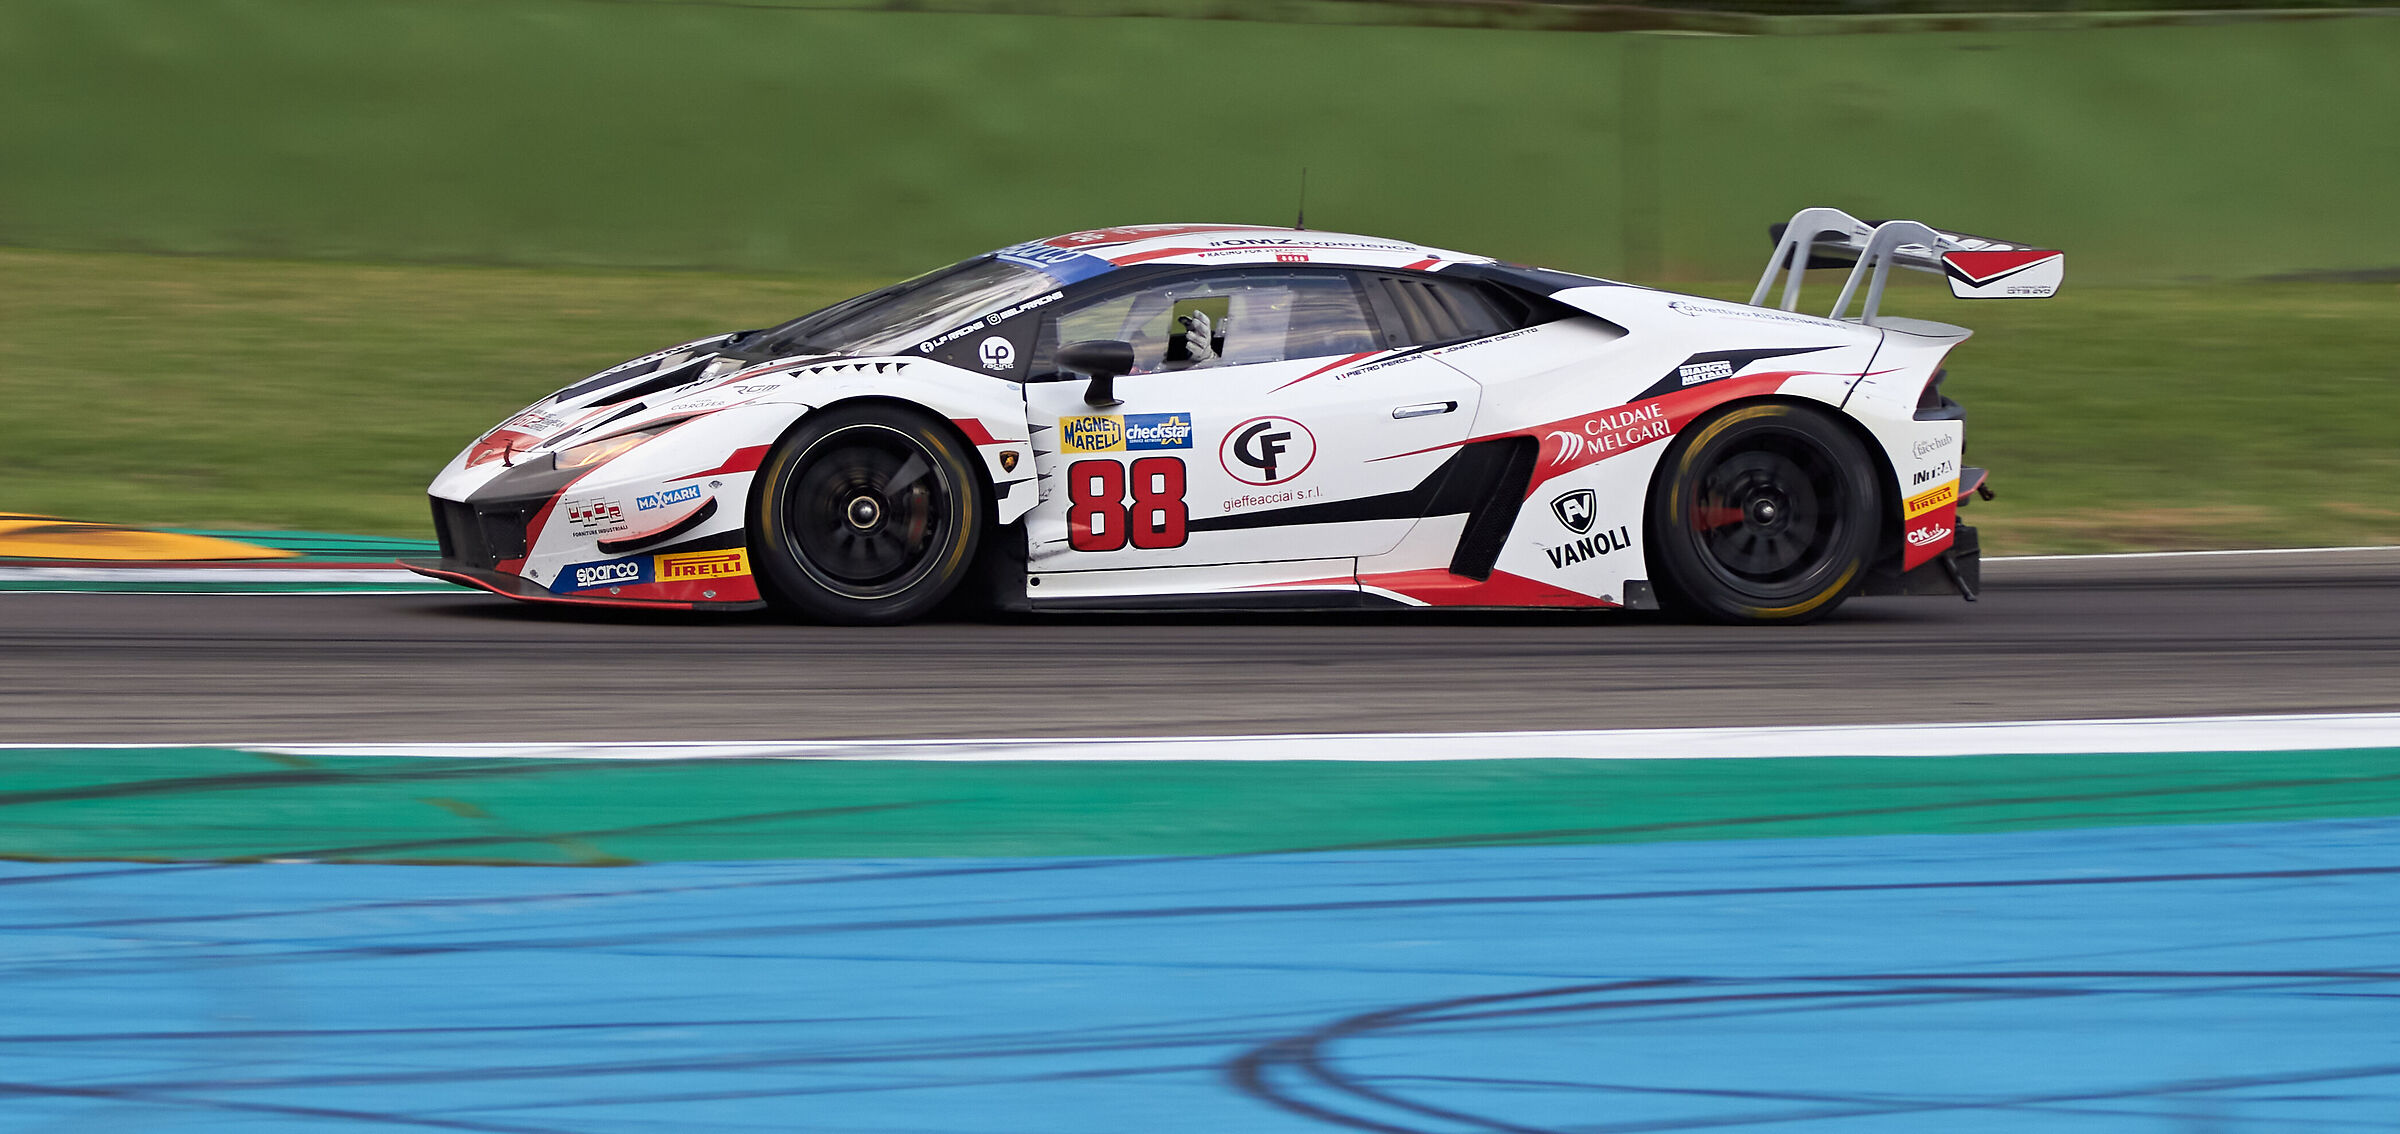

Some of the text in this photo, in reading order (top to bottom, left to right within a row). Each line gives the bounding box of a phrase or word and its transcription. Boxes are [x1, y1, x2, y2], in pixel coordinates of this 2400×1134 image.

[933, 321, 985, 347] LP RACING
[1495, 328, 1538, 341] CECOTTO
[1346, 364, 1380, 377] PIETRO
[1064, 416, 1121, 442] MAGNETI
[1126, 424, 1191, 440] checkstar
[1584, 403, 1663, 436] CALDAIE
[1587, 419, 1670, 456] MELGARI
[637, 485, 700, 511] MAXMARK
[1067, 456, 1190, 552] 88
[1223, 486, 1323, 512] gieffeacciai s.r.l.
[1908, 487, 1952, 512] PIRELLI
[1546, 525, 1632, 569] VANOLI
[576, 561, 639, 587] sparco
[663, 553, 741, 578] PIRELLI
